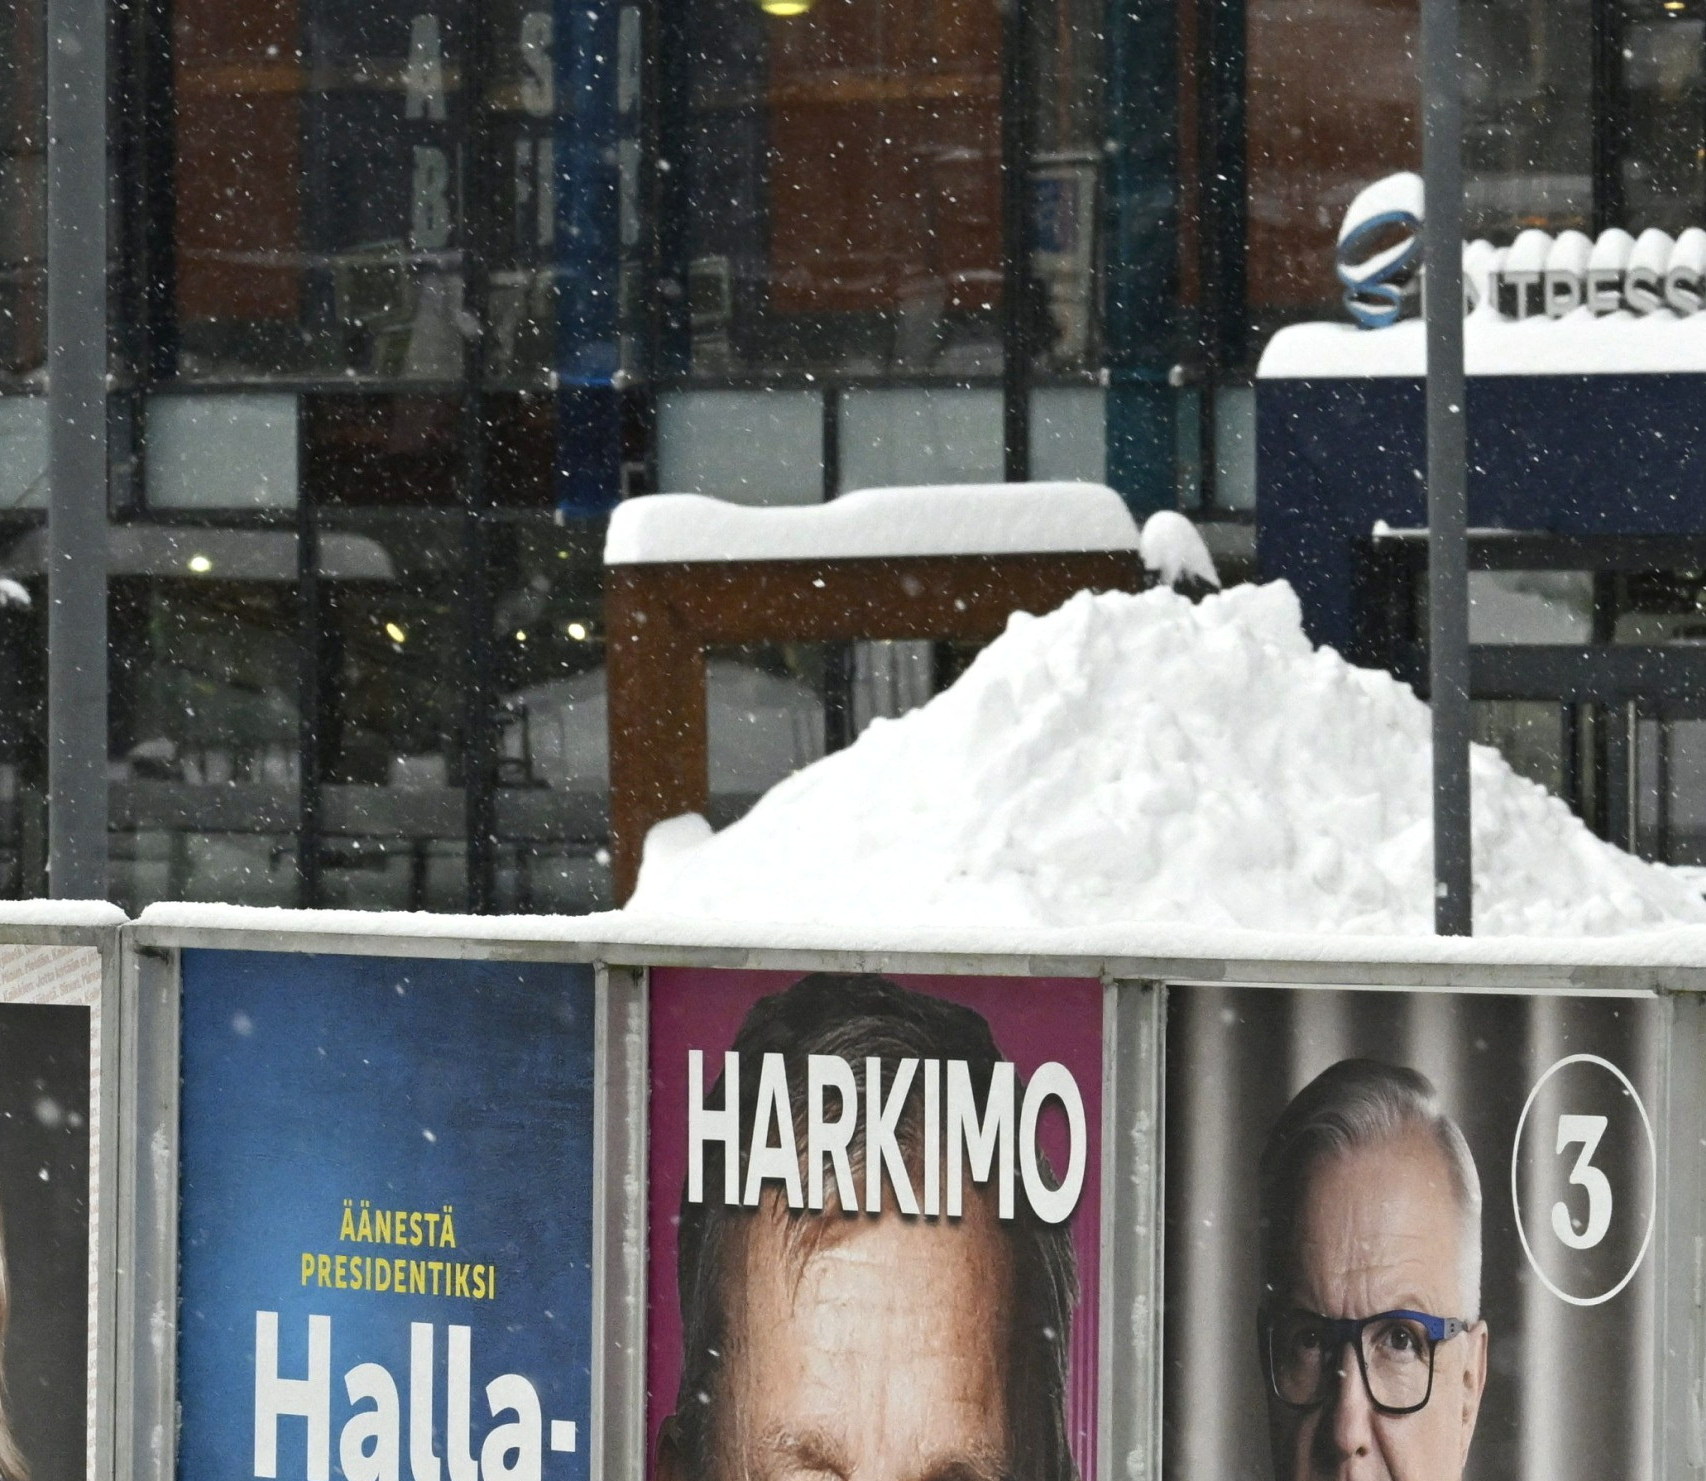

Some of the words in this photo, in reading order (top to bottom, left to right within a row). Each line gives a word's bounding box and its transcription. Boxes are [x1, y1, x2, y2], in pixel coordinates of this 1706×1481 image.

[688, 1049, 1087, 1224] HARKIMO
[1551, 1114, 1613, 1250] 3
[339, 1199, 456, 1249] ÄÄNESTÄ
[301, 1252, 496, 1300] PRESIDENTIKSI
